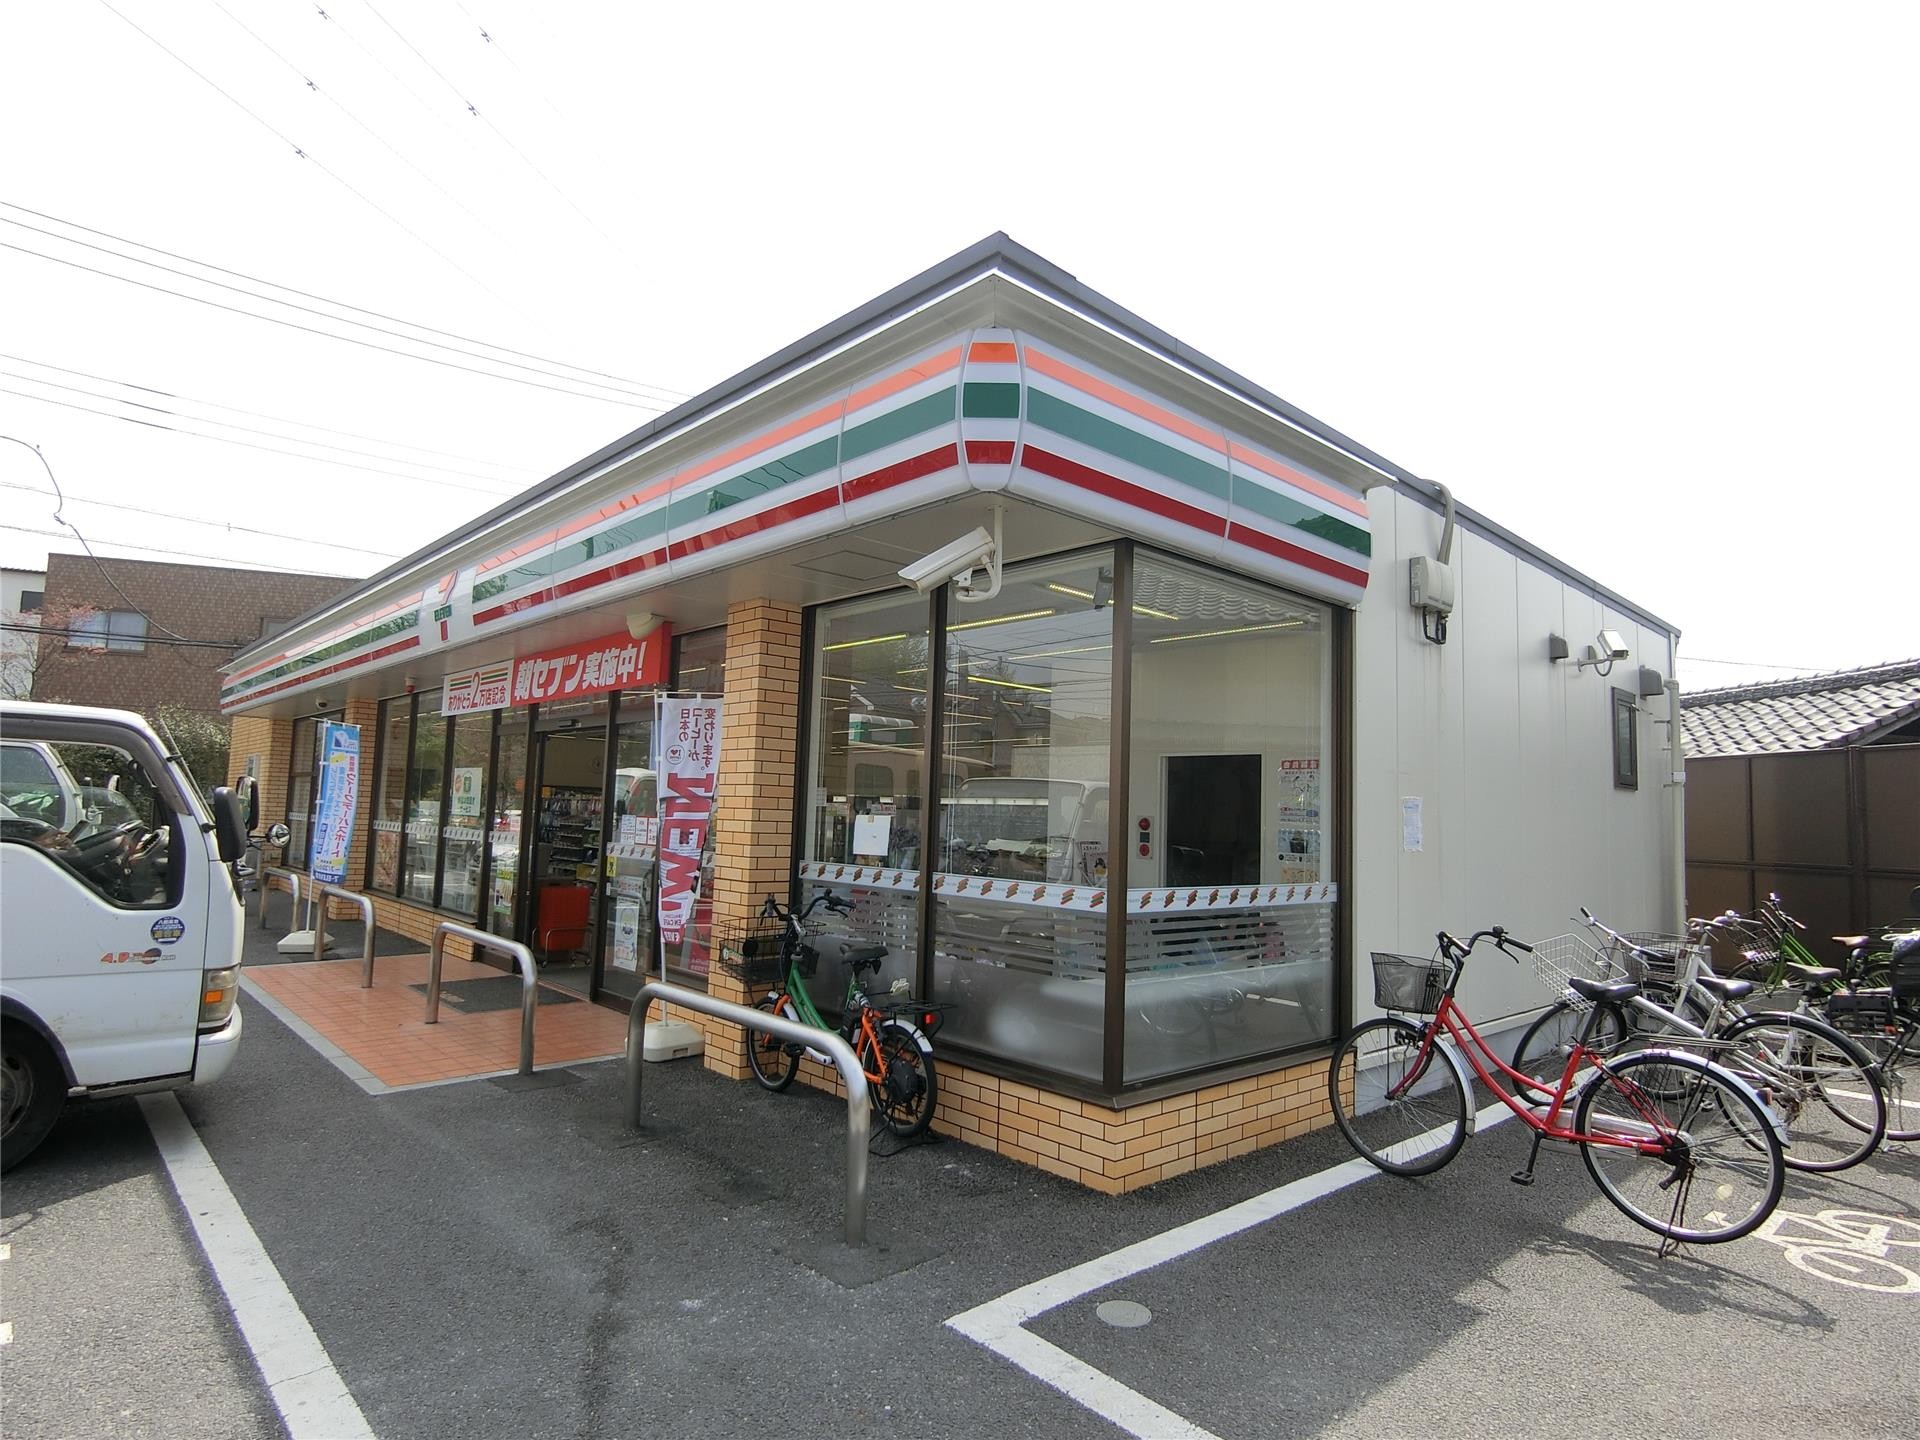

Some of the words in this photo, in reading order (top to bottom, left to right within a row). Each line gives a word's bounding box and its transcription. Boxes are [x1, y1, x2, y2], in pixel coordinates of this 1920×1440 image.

[514, 641, 647, 701] 朝セブン実施中!
